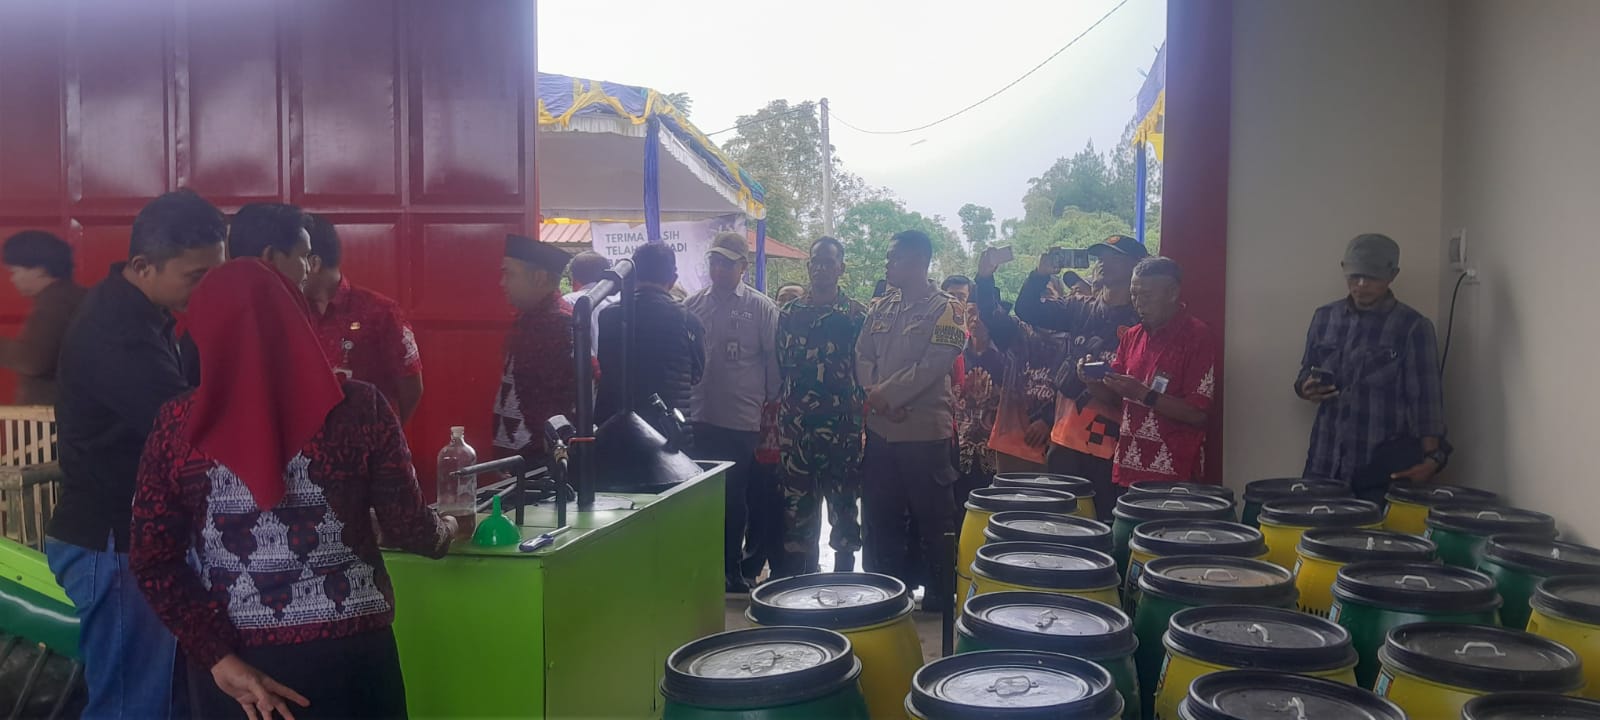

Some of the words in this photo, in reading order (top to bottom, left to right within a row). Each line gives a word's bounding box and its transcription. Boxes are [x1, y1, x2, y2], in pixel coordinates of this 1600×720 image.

[605, 232, 645, 243] TERIMA
[663, 230, 680, 241] SIH
[605, 244, 637, 256] TELAH
